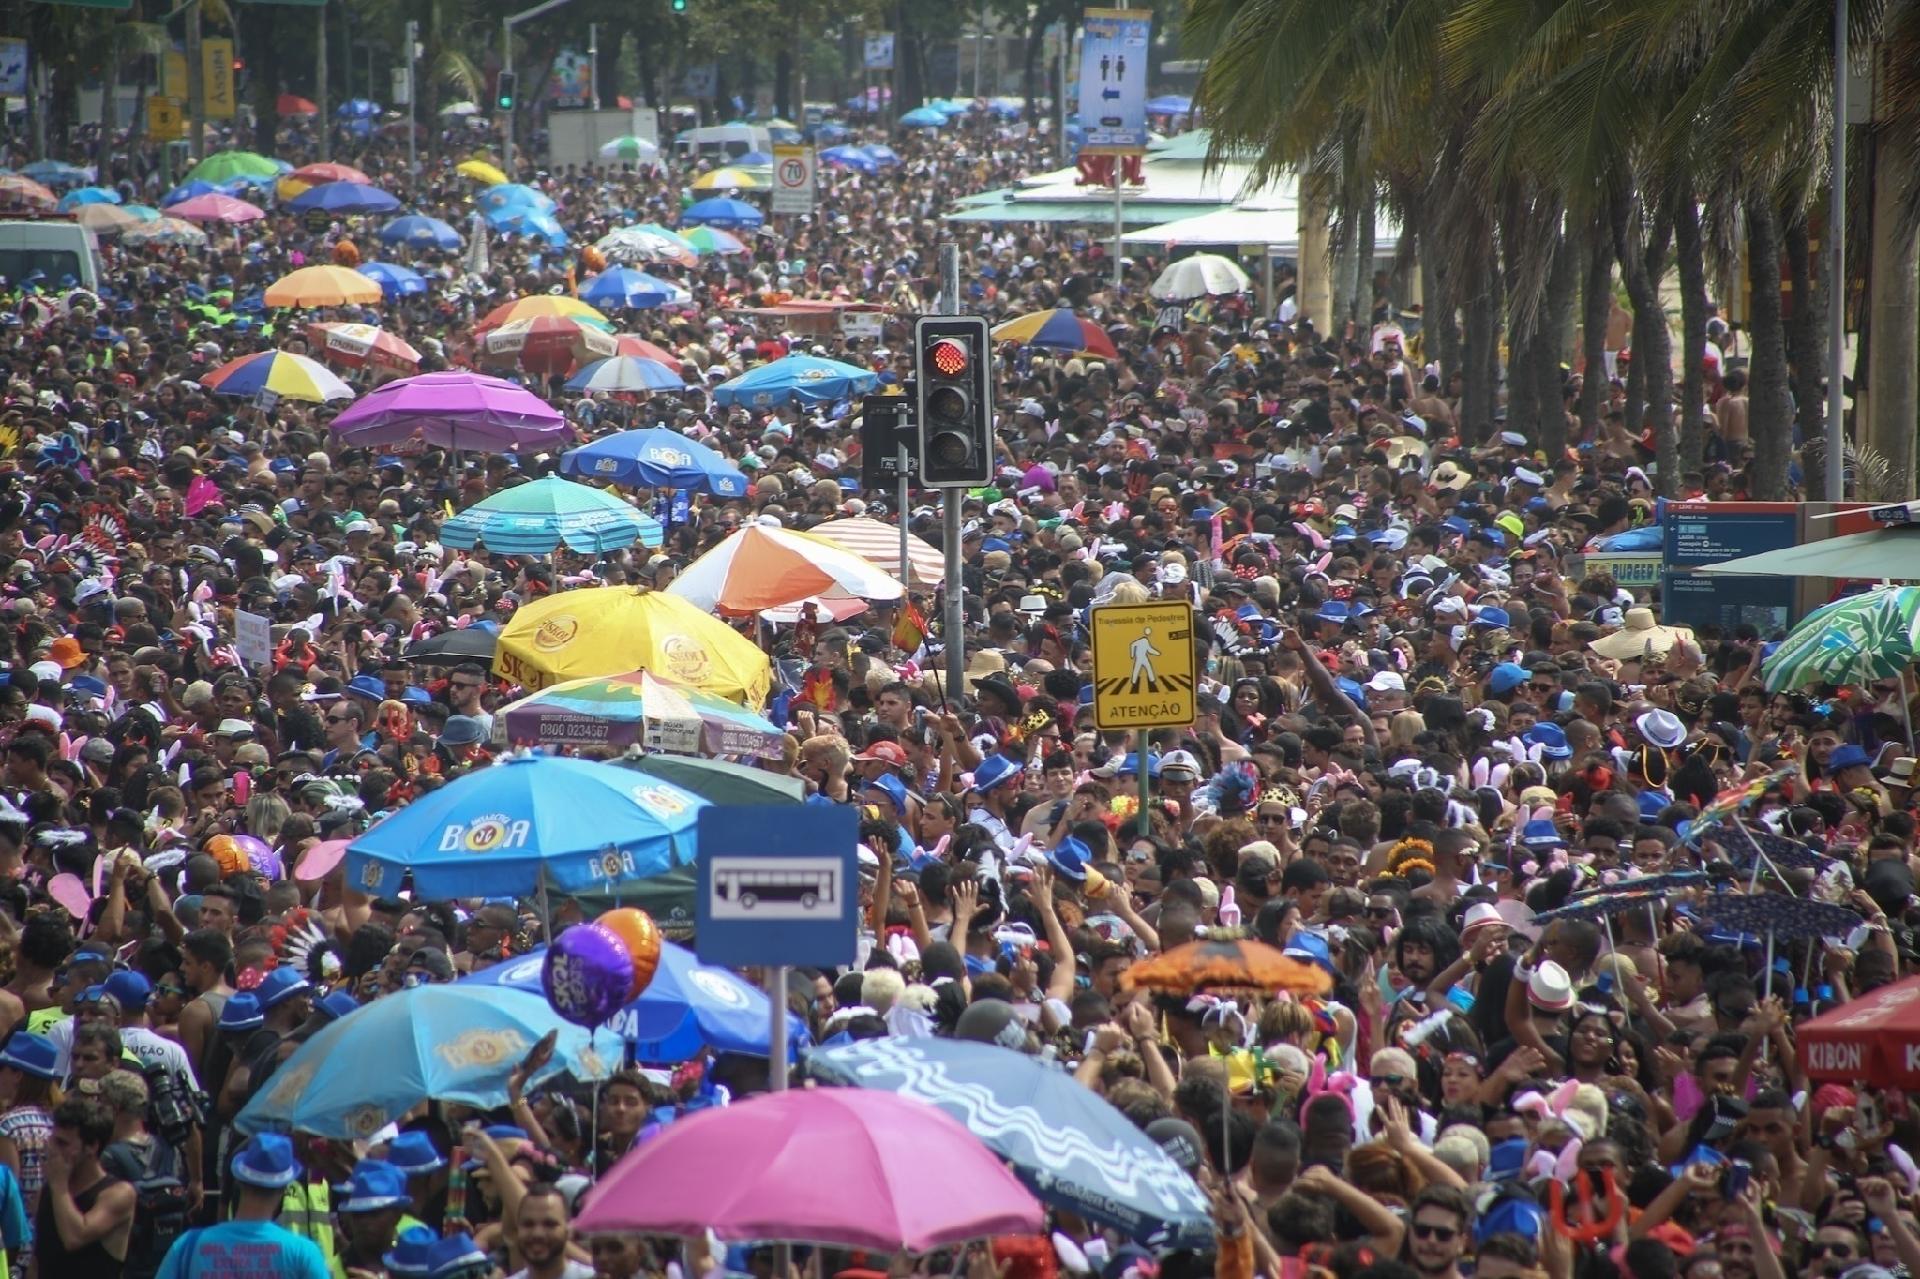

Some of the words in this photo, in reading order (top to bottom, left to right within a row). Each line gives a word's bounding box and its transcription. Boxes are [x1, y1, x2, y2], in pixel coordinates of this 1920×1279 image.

[786, 164, 801, 179] 70
[1612, 563, 1654, 580] BURGER
[1134, 616, 1145, 624] de
[1147, 614, 1186, 624] Pedestres
[1110, 700, 1181, 719] ATENÇÃO
[540, 723, 564, 736] 0800
[567, 724, 609, 738] 0234567
[438, 818, 531, 852] BOA
[552, 952, 573, 1010] SKOL
[1807, 1042, 1862, 1070] KIBON
